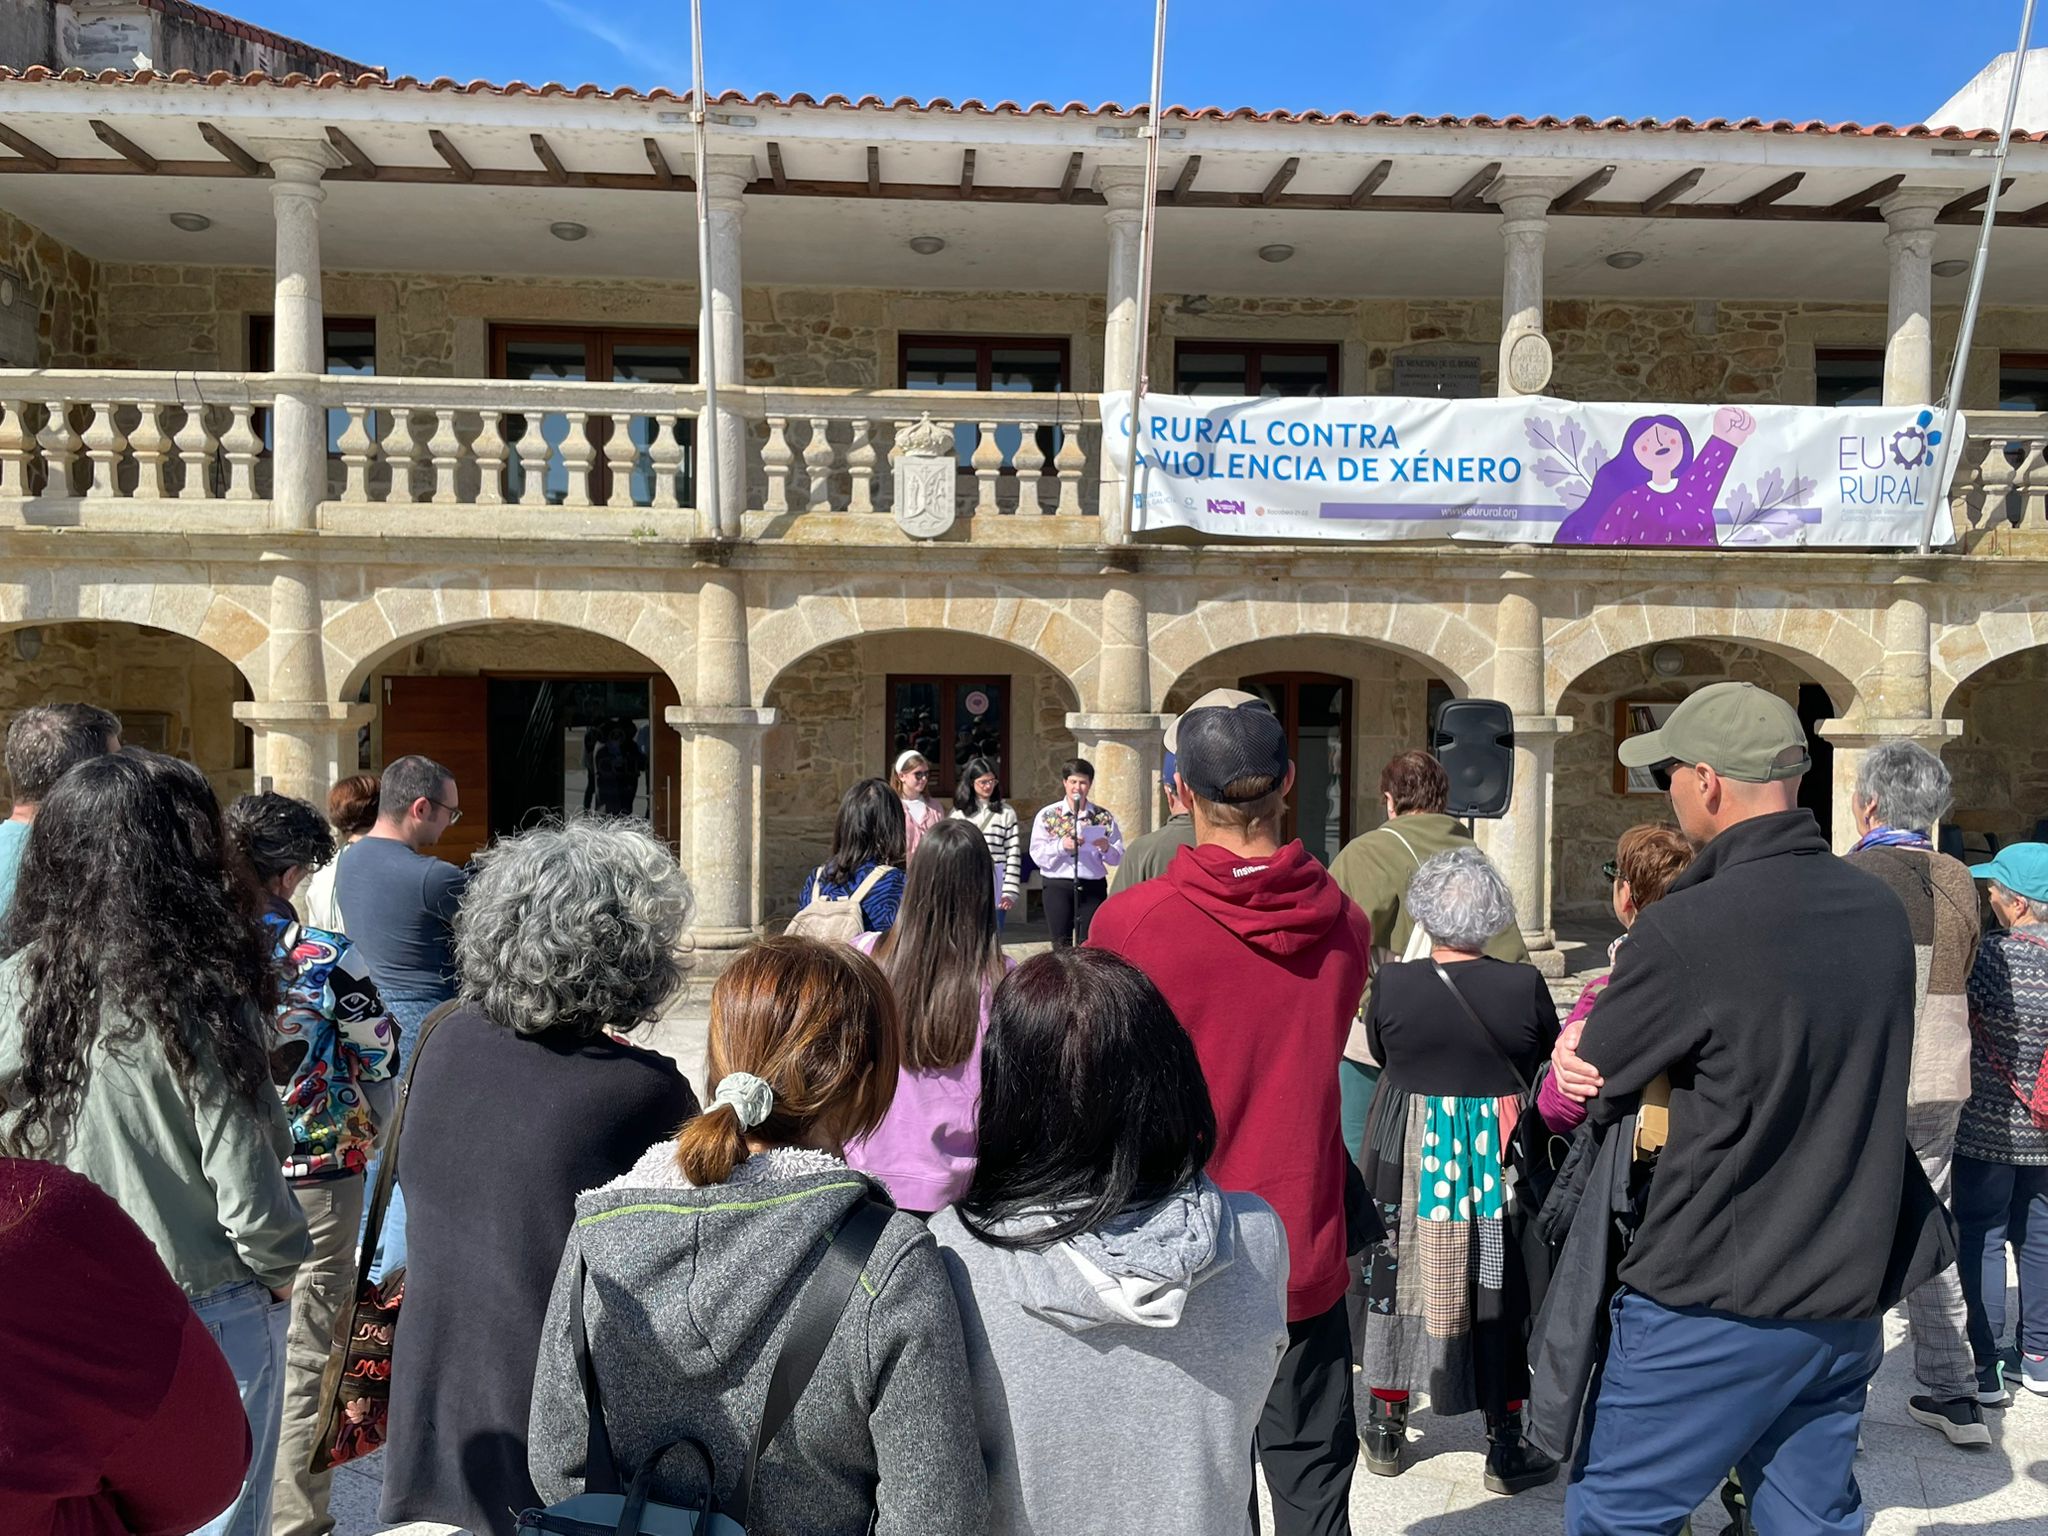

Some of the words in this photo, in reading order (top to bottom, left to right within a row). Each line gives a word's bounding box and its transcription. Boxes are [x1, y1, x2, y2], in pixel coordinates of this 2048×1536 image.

[1120, 413, 1141, 437] O
[1151, 415, 1257, 446] RURAL
[1266, 420, 1401, 449] CONTRA
[1152, 448, 1327, 481] VIOLENCIA
[1338, 456, 1379, 483] DE
[1391, 448, 1521, 484] XÉNERO
[1206, 498, 1246, 514] NON
[1839, 475, 1925, 506] RURAL
[1440, 506, 1518, 520] www.eurural.org
